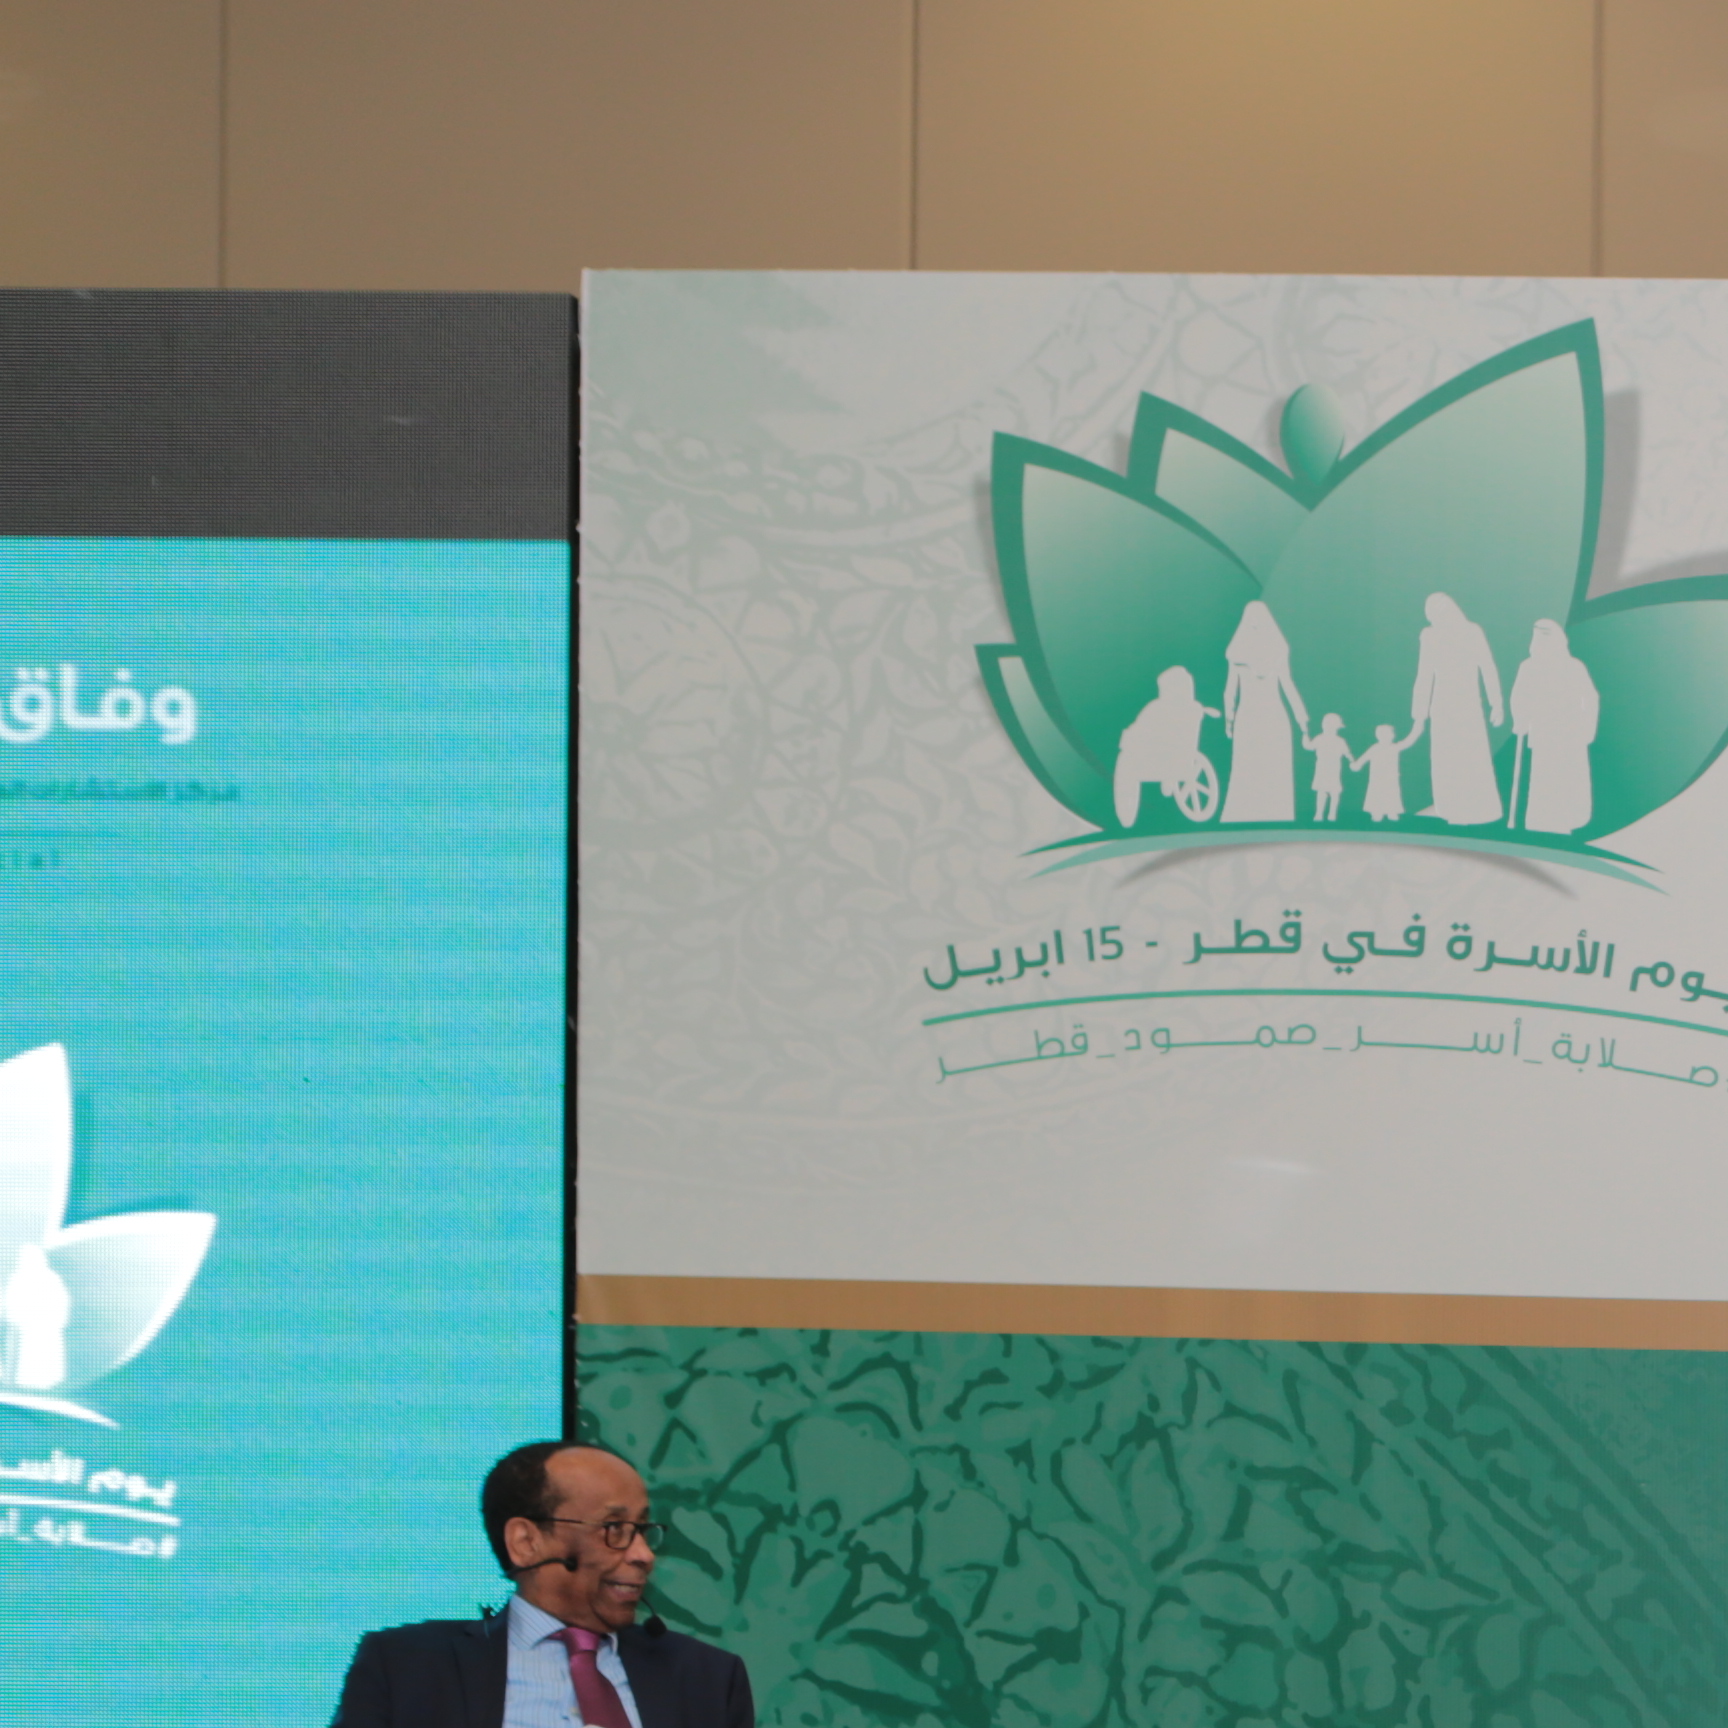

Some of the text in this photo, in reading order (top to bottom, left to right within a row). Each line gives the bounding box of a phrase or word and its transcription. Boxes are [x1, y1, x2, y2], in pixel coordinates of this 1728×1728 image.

[922, 929, 1066, 992] ابريل
[1083, 924, 1125, 963] 15
[1182, 909, 1303, 965] قطر
[1321, 911, 1428, 976] في
[1445, 921, 1616, 979] الأسرة
